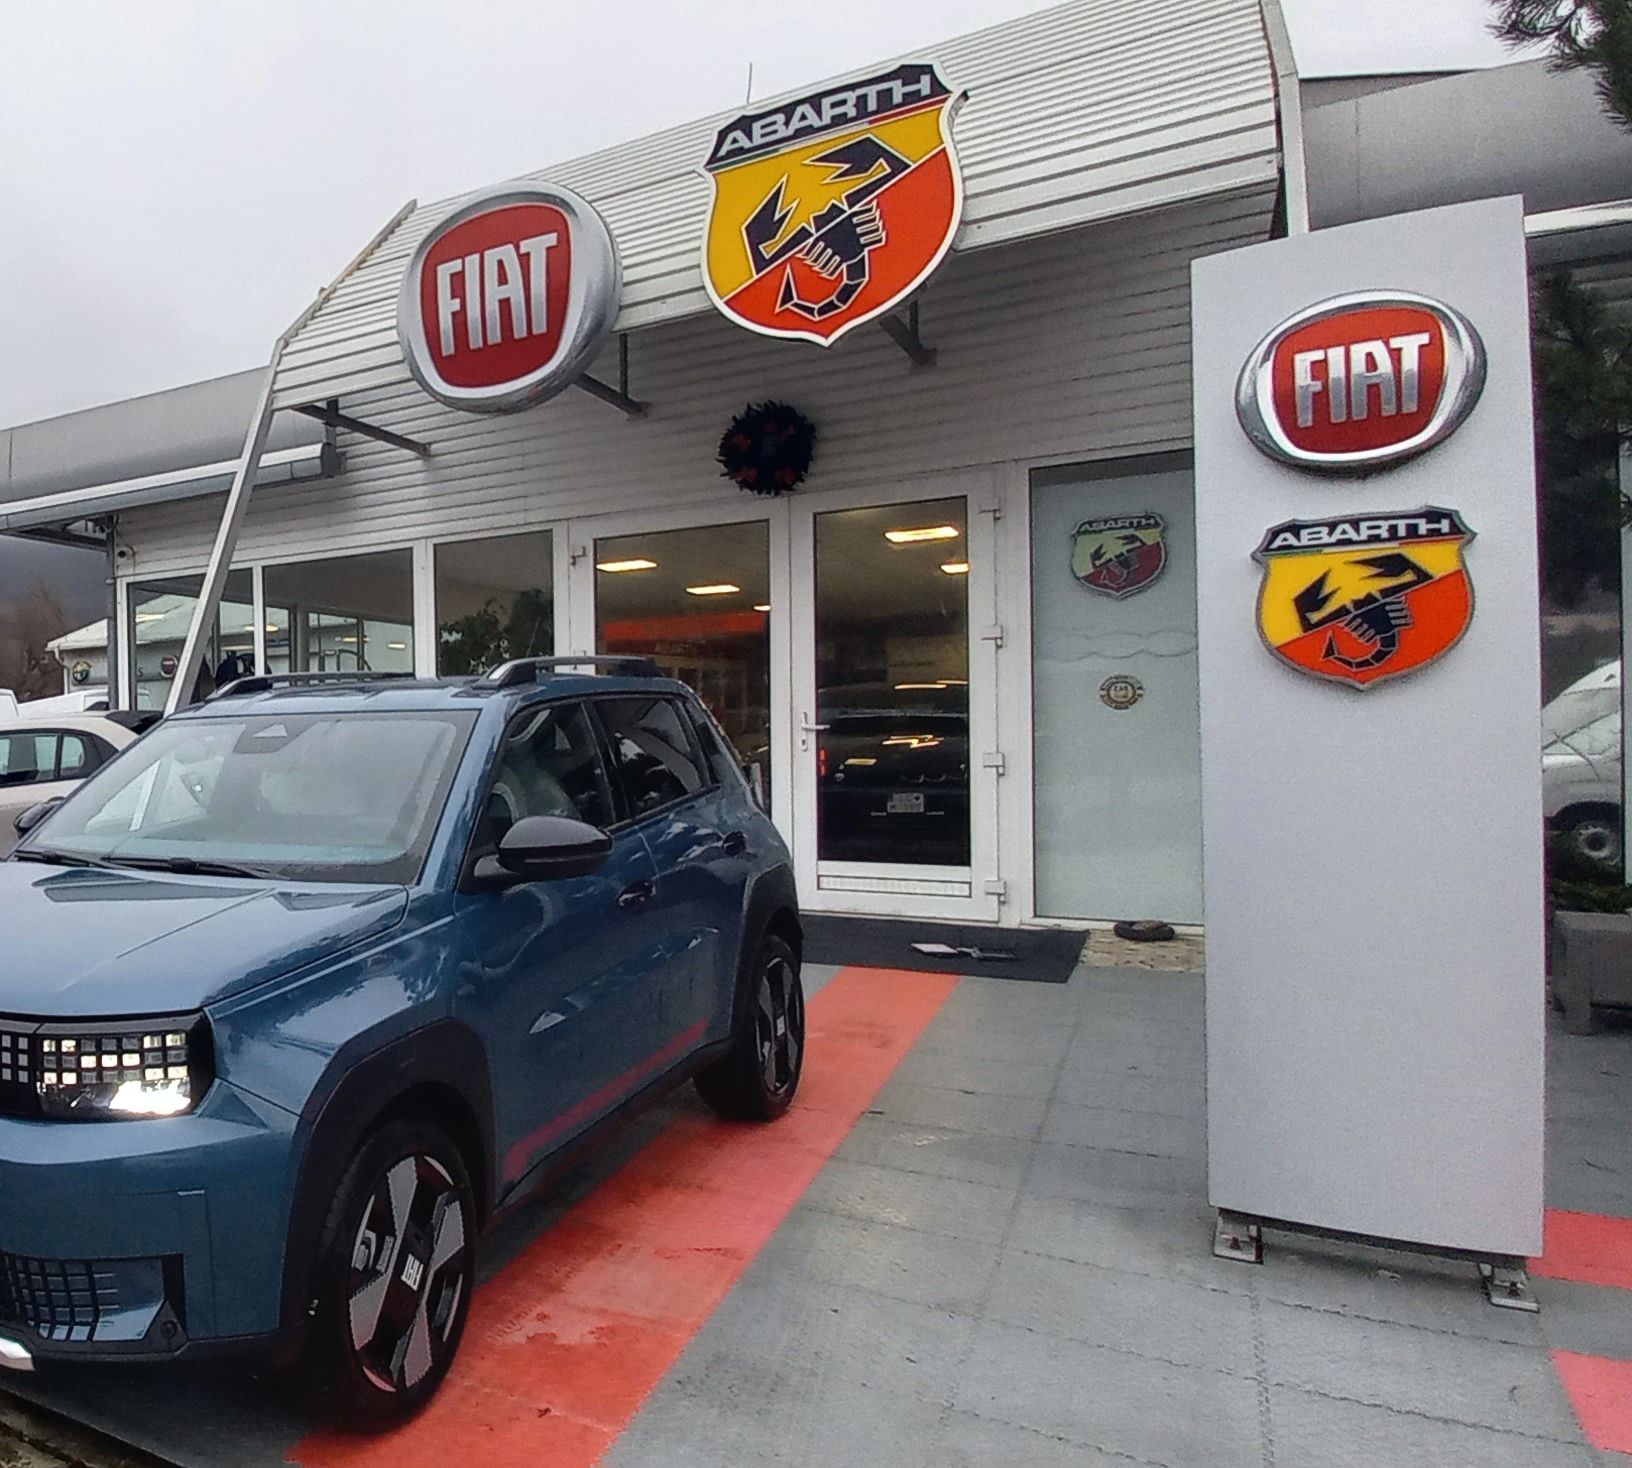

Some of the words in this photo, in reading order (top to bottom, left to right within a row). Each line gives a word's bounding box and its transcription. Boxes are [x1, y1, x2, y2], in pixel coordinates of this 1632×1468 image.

[716, 74, 932, 158] ABARTH
[435, 231, 560, 357] FIAT
[1293, 332, 1430, 428] FIAT
[1079, 518, 1155, 532] ABARTH
[1270, 517, 1450, 549] ABARTH
